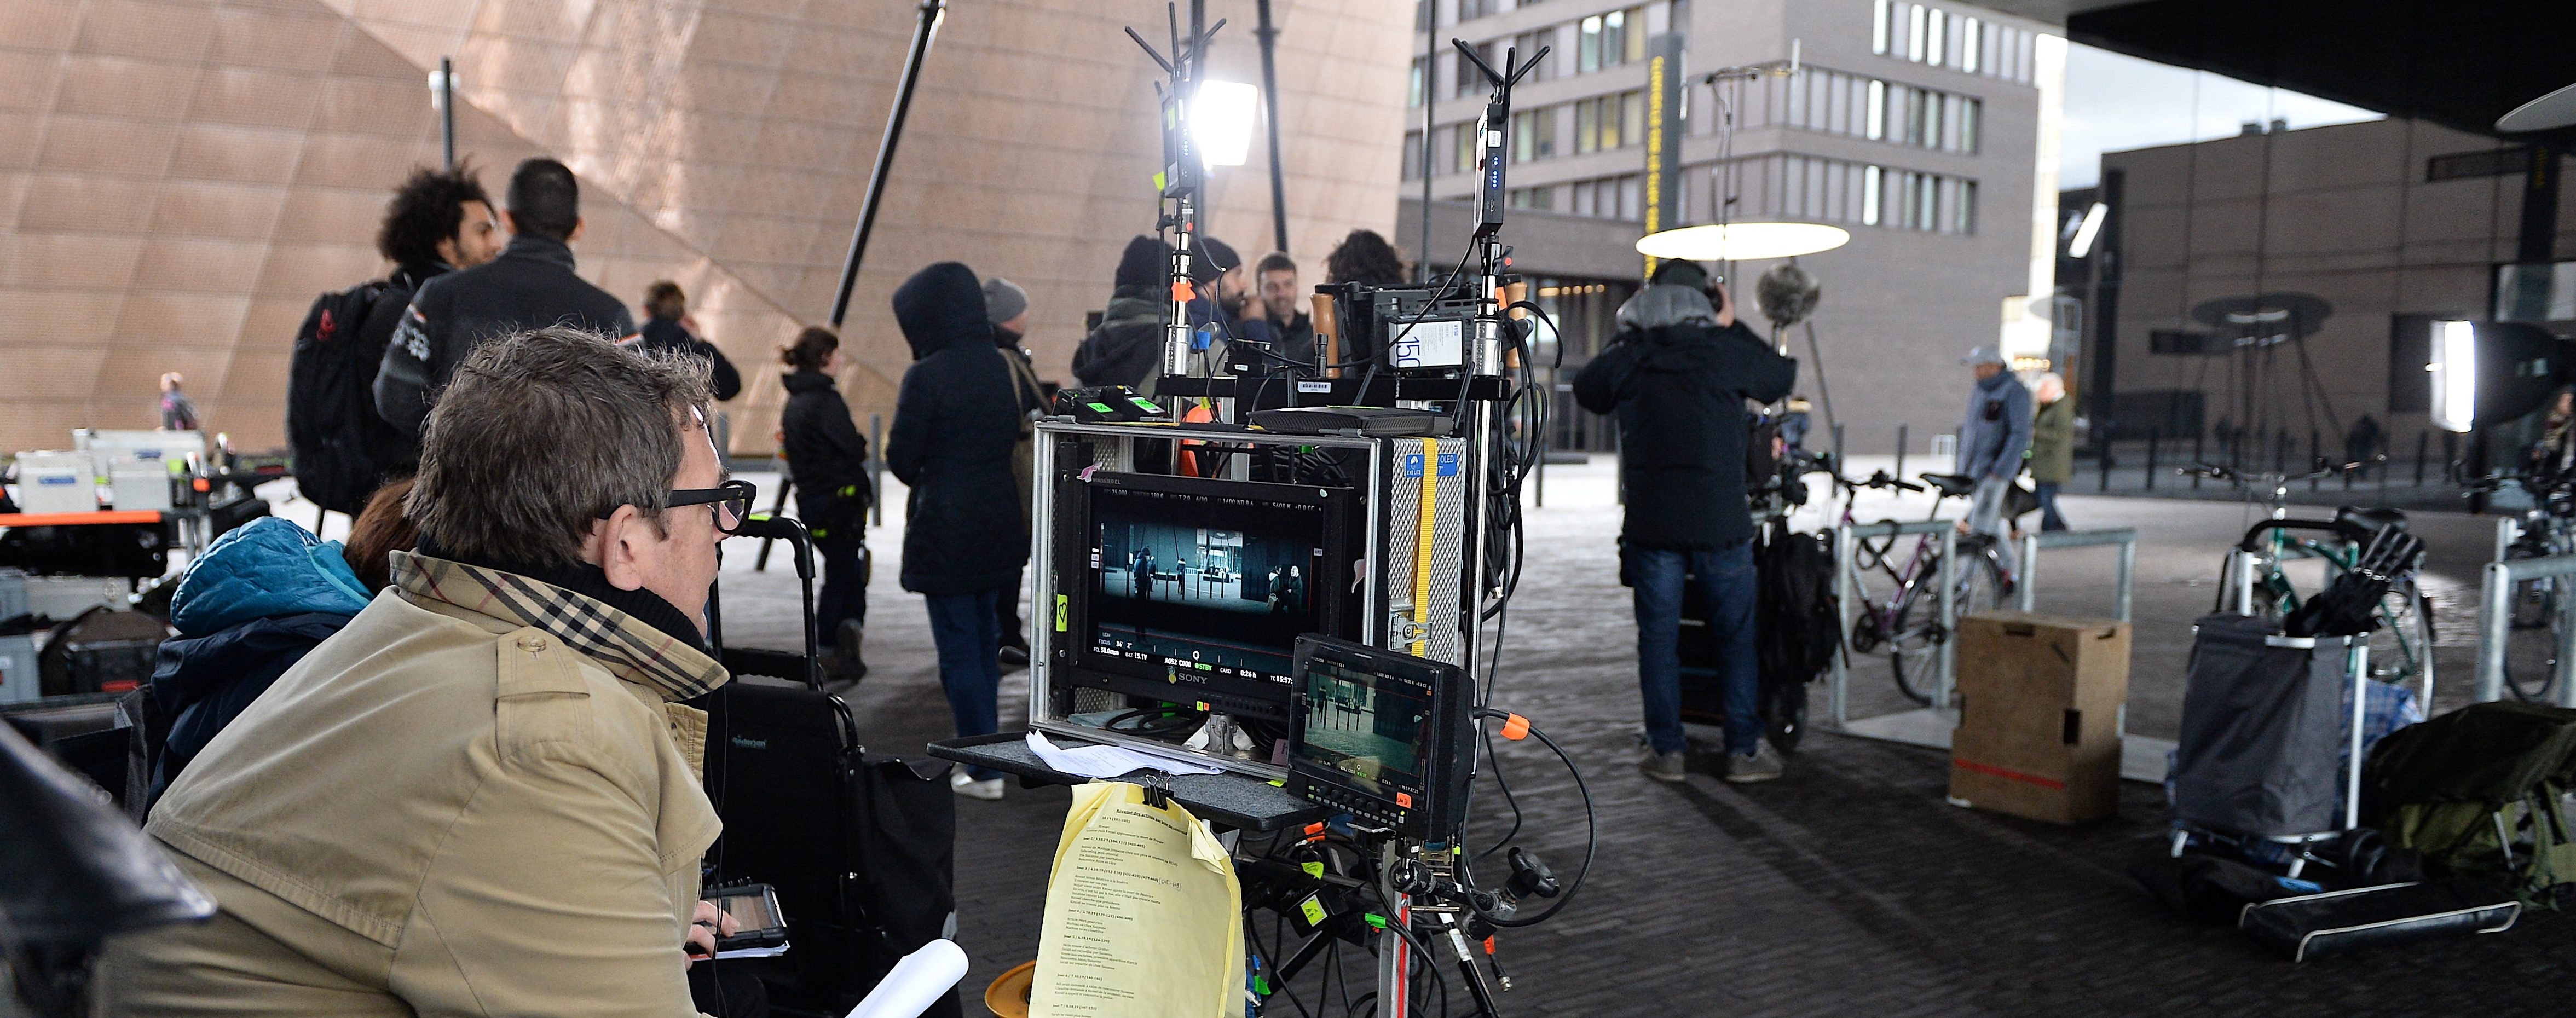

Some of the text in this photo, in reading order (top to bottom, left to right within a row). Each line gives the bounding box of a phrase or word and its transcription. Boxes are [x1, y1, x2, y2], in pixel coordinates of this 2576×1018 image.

[1396, 337, 1420, 368] 150
[1440, 455, 1454, 464] OLED
[1164, 657, 1177, 666] A052
[1240, 669, 1252, 678] 0:26
[1179, 673, 1208, 684] SONY
